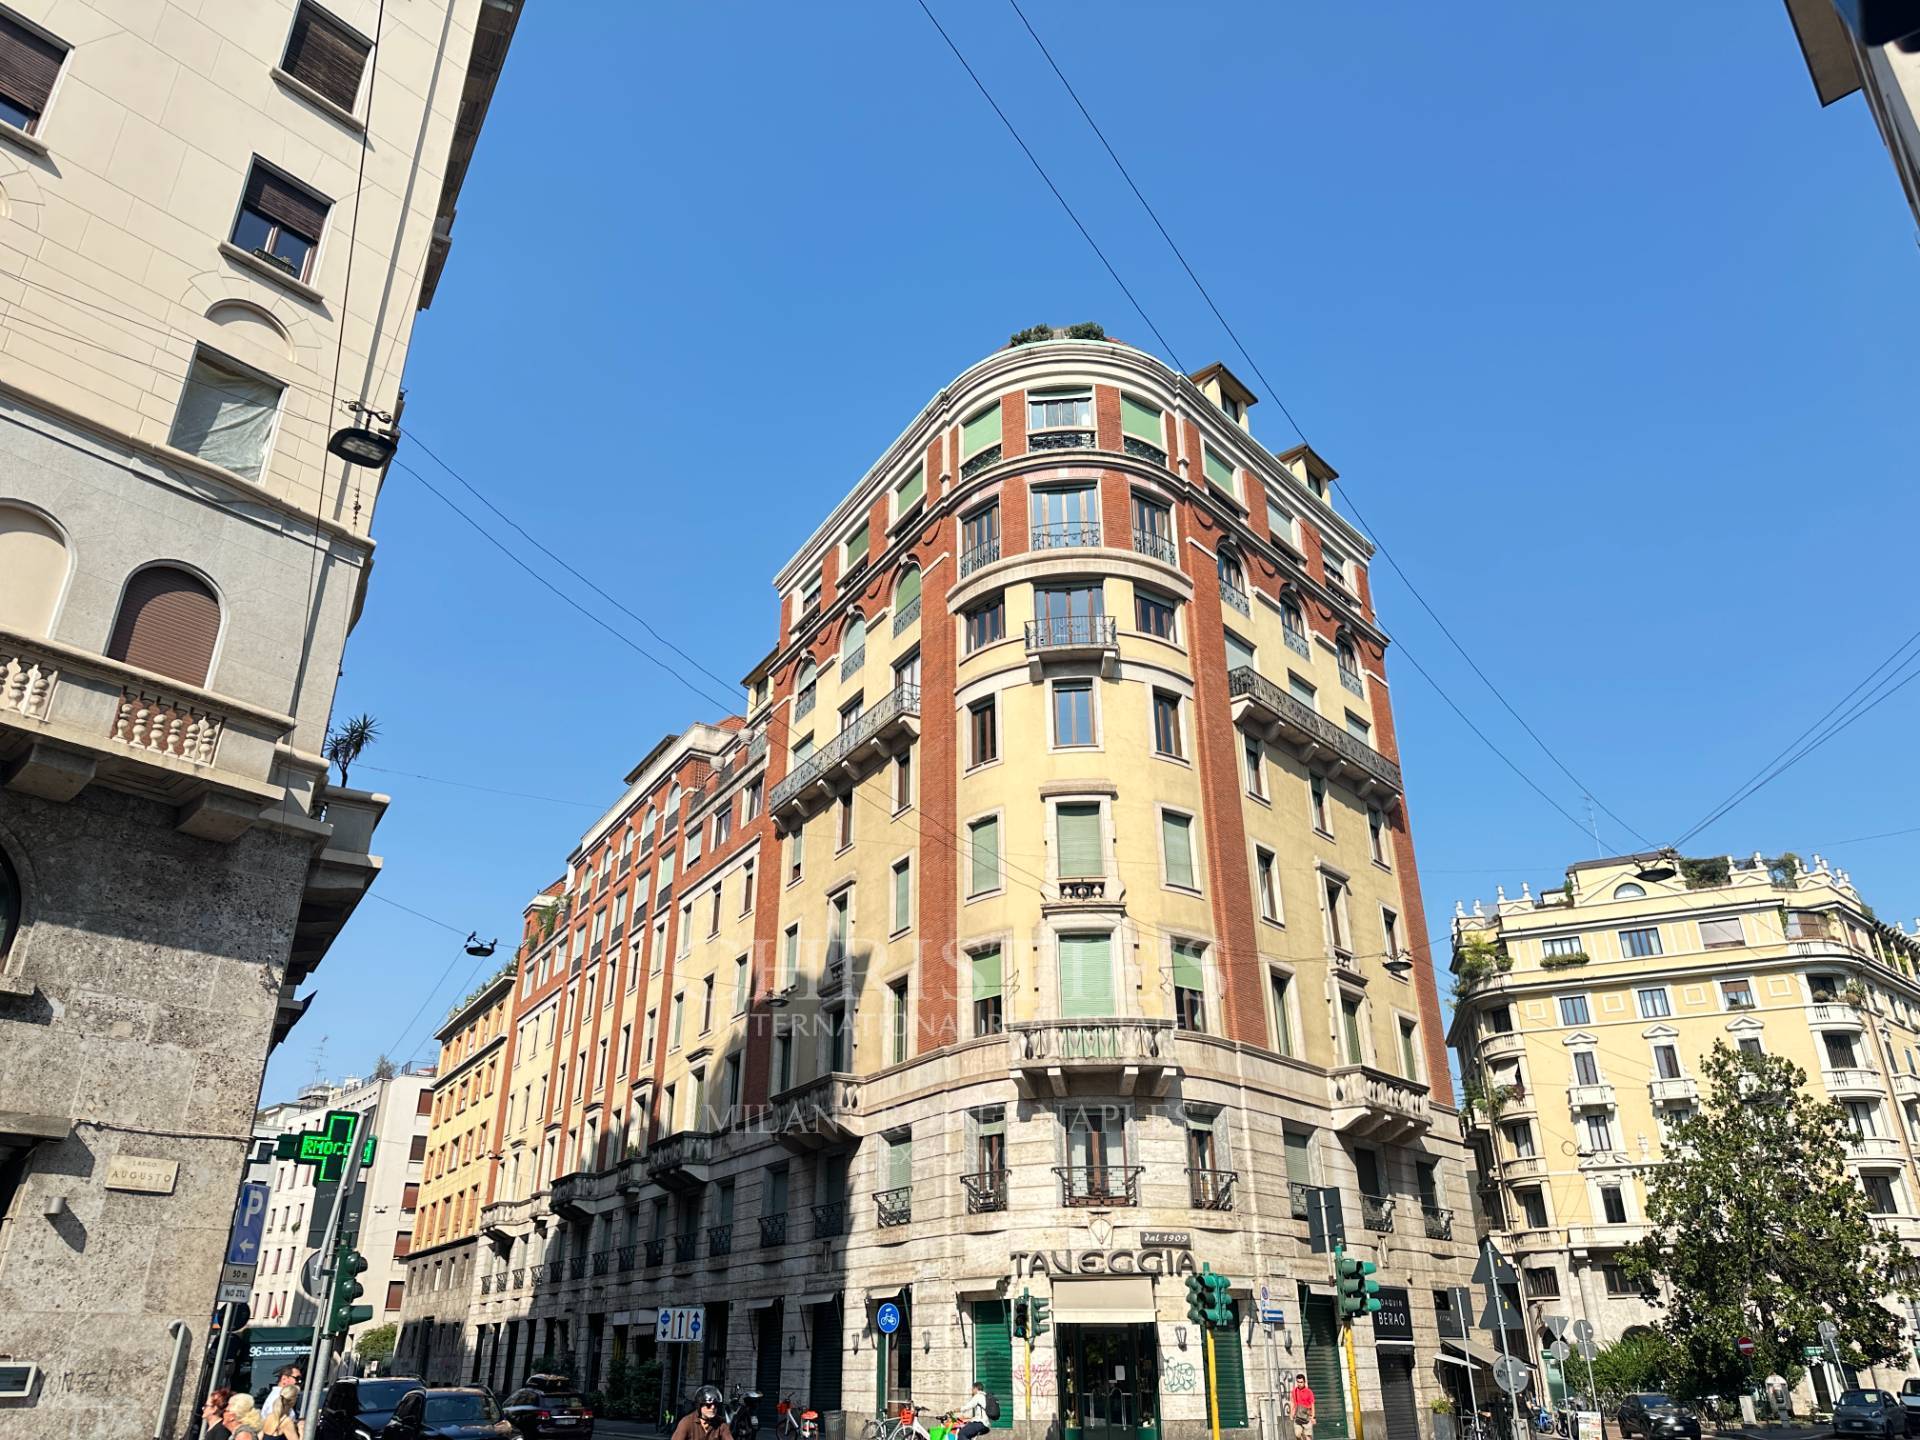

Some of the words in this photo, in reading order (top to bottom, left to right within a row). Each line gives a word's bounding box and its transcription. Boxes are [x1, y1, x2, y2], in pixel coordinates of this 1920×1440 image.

[111, 1170, 172, 1183] AUGUSTO
[243, 1190, 264, 1227] P
[1144, 1232, 1160, 1242] dal
[1163, 1233, 1188, 1243] 1909
[1010, 1249, 1197, 1278] TAVEGGIA
[232, 1269, 241, 1278] 50
[224, 1289, 235, 1297] NO
[236, 1289, 246, 1298] ZTL
[1379, 1298, 1403, 1307] OAQUIN
[1378, 1312, 1406, 1326] BERAO
[249, 1346, 262, 1357] 96
